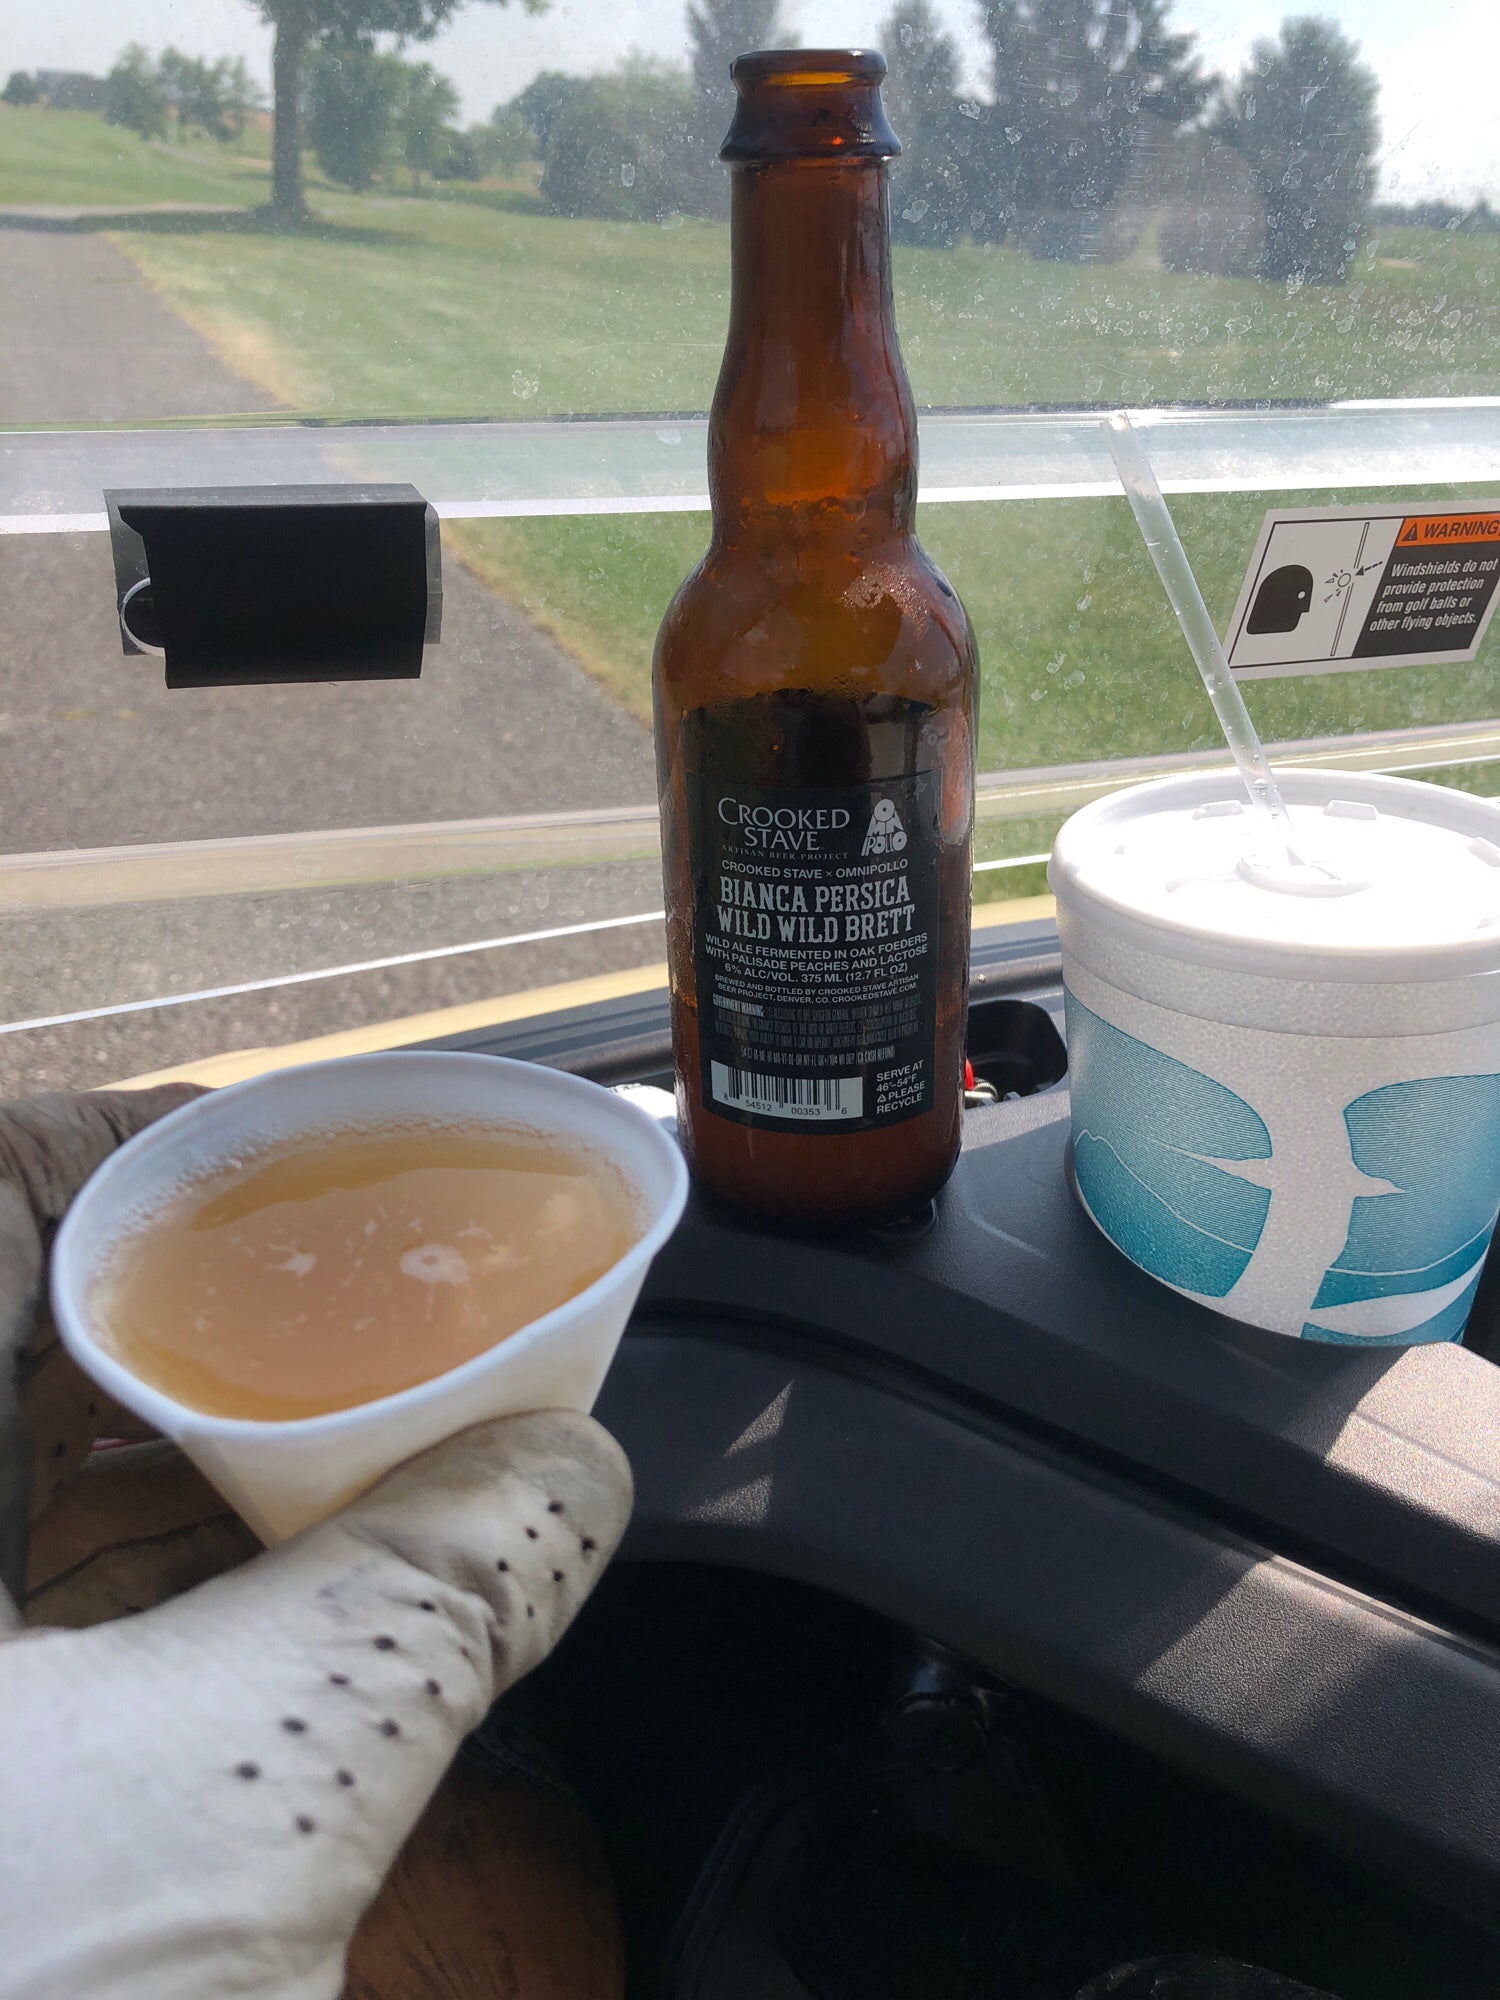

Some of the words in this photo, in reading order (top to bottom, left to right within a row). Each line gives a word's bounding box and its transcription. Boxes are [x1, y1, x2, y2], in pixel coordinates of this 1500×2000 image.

[1424, 519, 1500, 538] WARNING
[1392, 561, 1461, 577] Windshields
[1462, 559, 1476, 572] do
[1479, 558, 1498, 571] not
[1382, 581, 1426, 598] provide
[1427, 577, 1484, 595] protection
[1377, 601, 1403, 613] from
[1405, 598, 1429, 614] golf
[1429, 596, 1458, 609] balls
[1459, 597, 1472, 607] or
[1370, 618, 1400, 631] other
[1401, 616, 1434, 631] flying
[1435, 612, 1476, 628] objects.
[744, 827, 820, 851] STAVE
[722, 844, 764, 857] ARTISAN
[769, 851, 795, 859] BEER
[801, 852, 848, 860] PROJECT
[722, 860, 780, 877] CROOKED
[784, 869, 822, 878] STAVE
[836, 859, 908, 878] OMNIPOLLO
[720, 876, 808, 912] BIANCA
[815, 876, 910, 913] PERSICA
[717, 905, 770, 939] WILD
[777, 915, 838, 943] WILD
[845, 904, 915, 942] BRETT
[705, 933, 730, 949] WILD
[732, 942, 753, 955] ALE
[756, 947, 831, 960] FERMENTED
[835, 950, 847, 958] IN
[850, 946, 875, 958] OAK
[878, 933, 928, 954] FOEDERS
[705, 944, 729, 960] WITH
[732, 954, 787, 970] PALISADE
[790, 961, 849, 972] PEACHES
[852, 958, 878, 969] AND
[880, 944, 928, 964] LACTOSE
[725, 963, 741, 975] 6%
[744, 967, 798, 982] ALC/VOL.
[801, 974, 821, 983] 375
[825, 973, 842, 982] ML
[846, 969, 871, 983] (12.7
[874, 968, 887, 979] FL
[890, 962, 908, 976] OZ)
[715, 974, 745, 987] BREWED
[747, 982, 763, 991] AND
[765, 985, 803, 995] BOTTLED
[805, 987, 816, 995] BY
[818, 986, 860, 995] CROOKED
[862, 980, 886, 991] STAVE
[888, 974, 919, 988] ARTISAN
[718, 983, 738, 995] BEER
[738, 987, 775, 1002] PROJECT,
[777, 994, 813, 1004] DENVER,
[832, 982, 917, 1002] CROOKEDSTAVE.COM
[876, 1065, 910, 1082] SERVE
[912, 1059, 924, 1071] AT
[888, 1080, 925, 1100] PLEASE
[746, 1100, 772, 1112] 54512
[791, 1108, 820, 1116] 00353
[876, 1092, 923, 1114] RECYCLE
